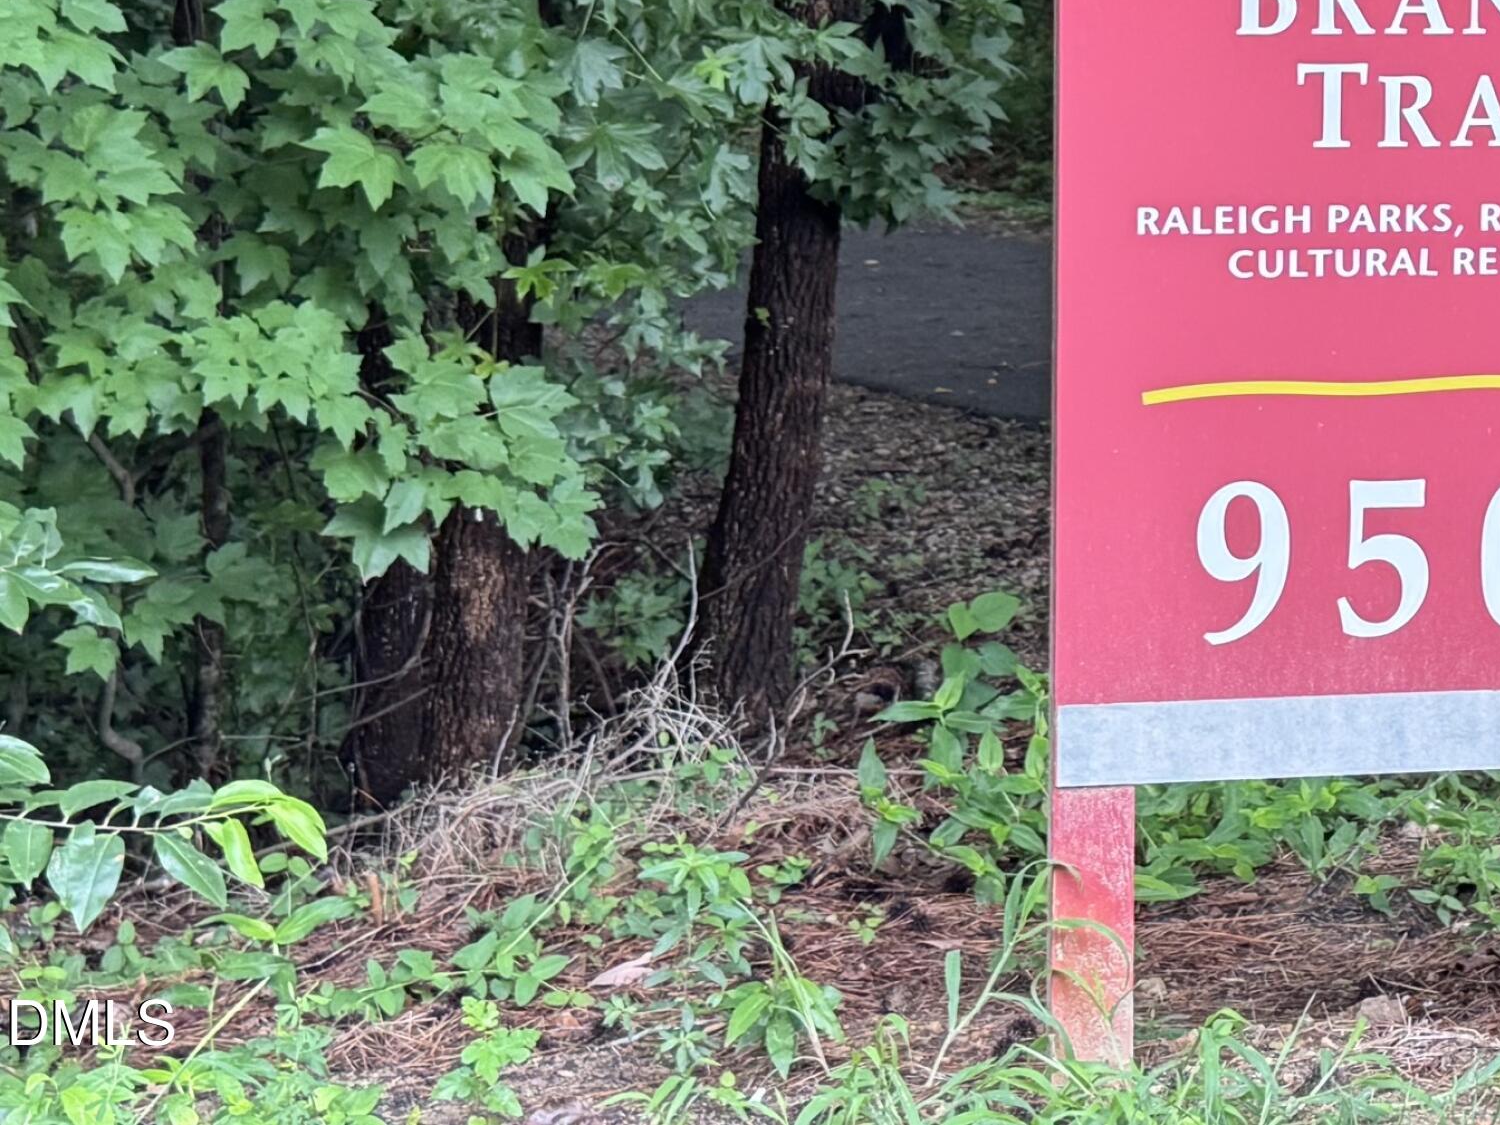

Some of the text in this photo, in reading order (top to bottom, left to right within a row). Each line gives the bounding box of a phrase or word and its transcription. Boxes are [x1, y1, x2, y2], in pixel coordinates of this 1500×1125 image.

[1137, 206, 1310, 235] RALEIGH
[1328, 204, 1463, 237] PARKS,
[1229, 248, 1438, 278] CULTURAL
